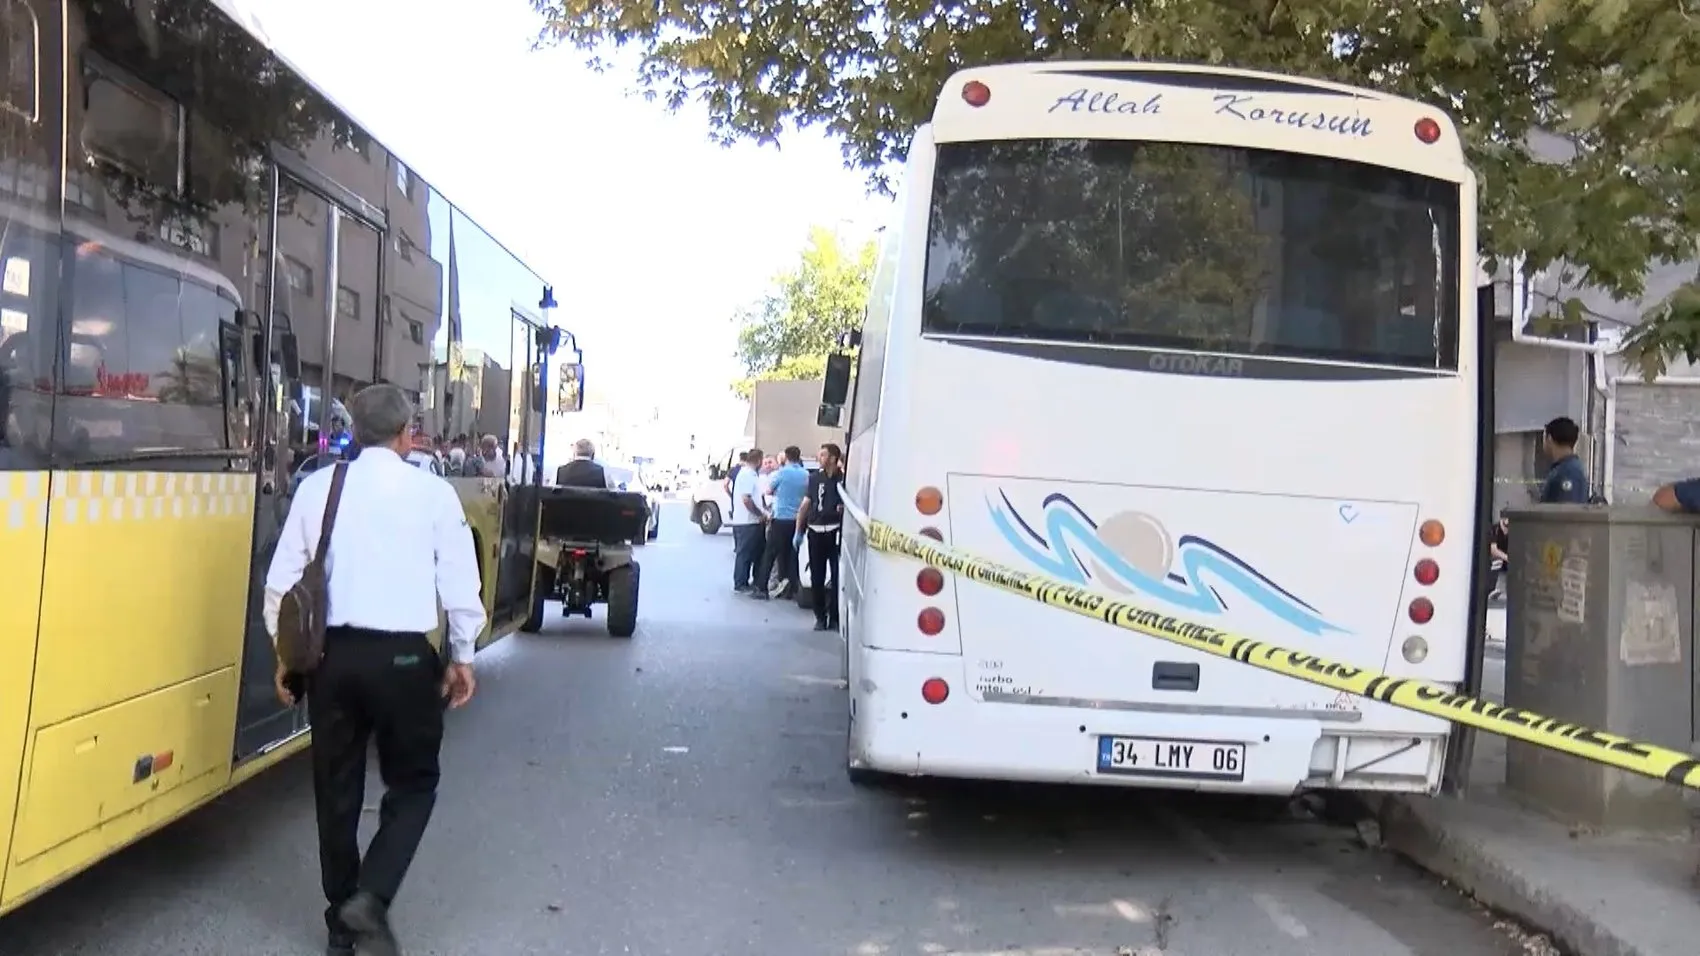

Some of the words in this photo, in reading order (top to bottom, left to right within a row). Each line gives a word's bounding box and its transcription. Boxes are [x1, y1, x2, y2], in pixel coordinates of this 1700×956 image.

[1047, 88, 1163, 115] Allah
[1213, 94, 1374, 137] Korusun
[1113, 741, 1138, 766] 34
[1155, 744, 1194, 769] LMY
[1213, 747, 1239, 772] 06
